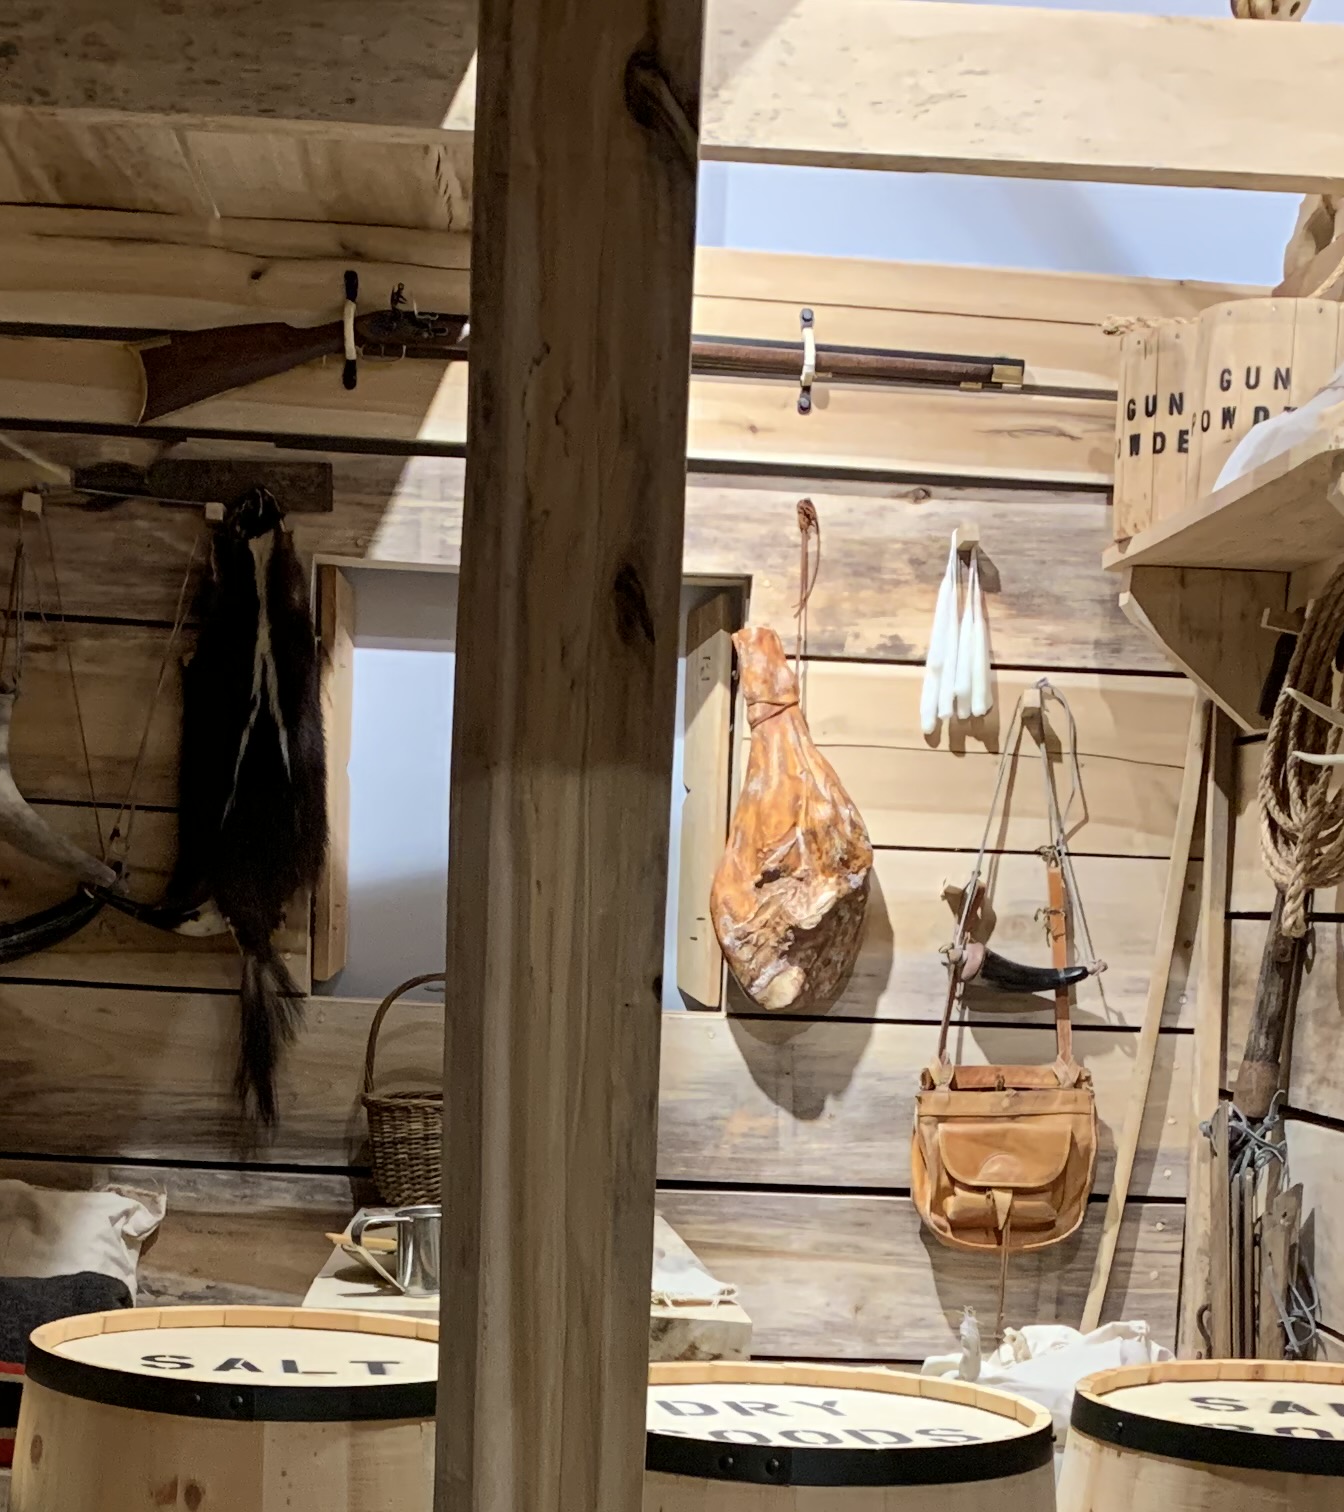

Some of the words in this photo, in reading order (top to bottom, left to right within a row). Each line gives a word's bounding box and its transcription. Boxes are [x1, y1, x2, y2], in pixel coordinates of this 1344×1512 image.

[1219, 366, 1291, 392] GUN
[1127, 392, 1184, 421] GUN
[140, 1354, 401, 1376] SALT
[654, 1399, 848, 1417] DRY
[648, 1428, 983, 1446] OODS
